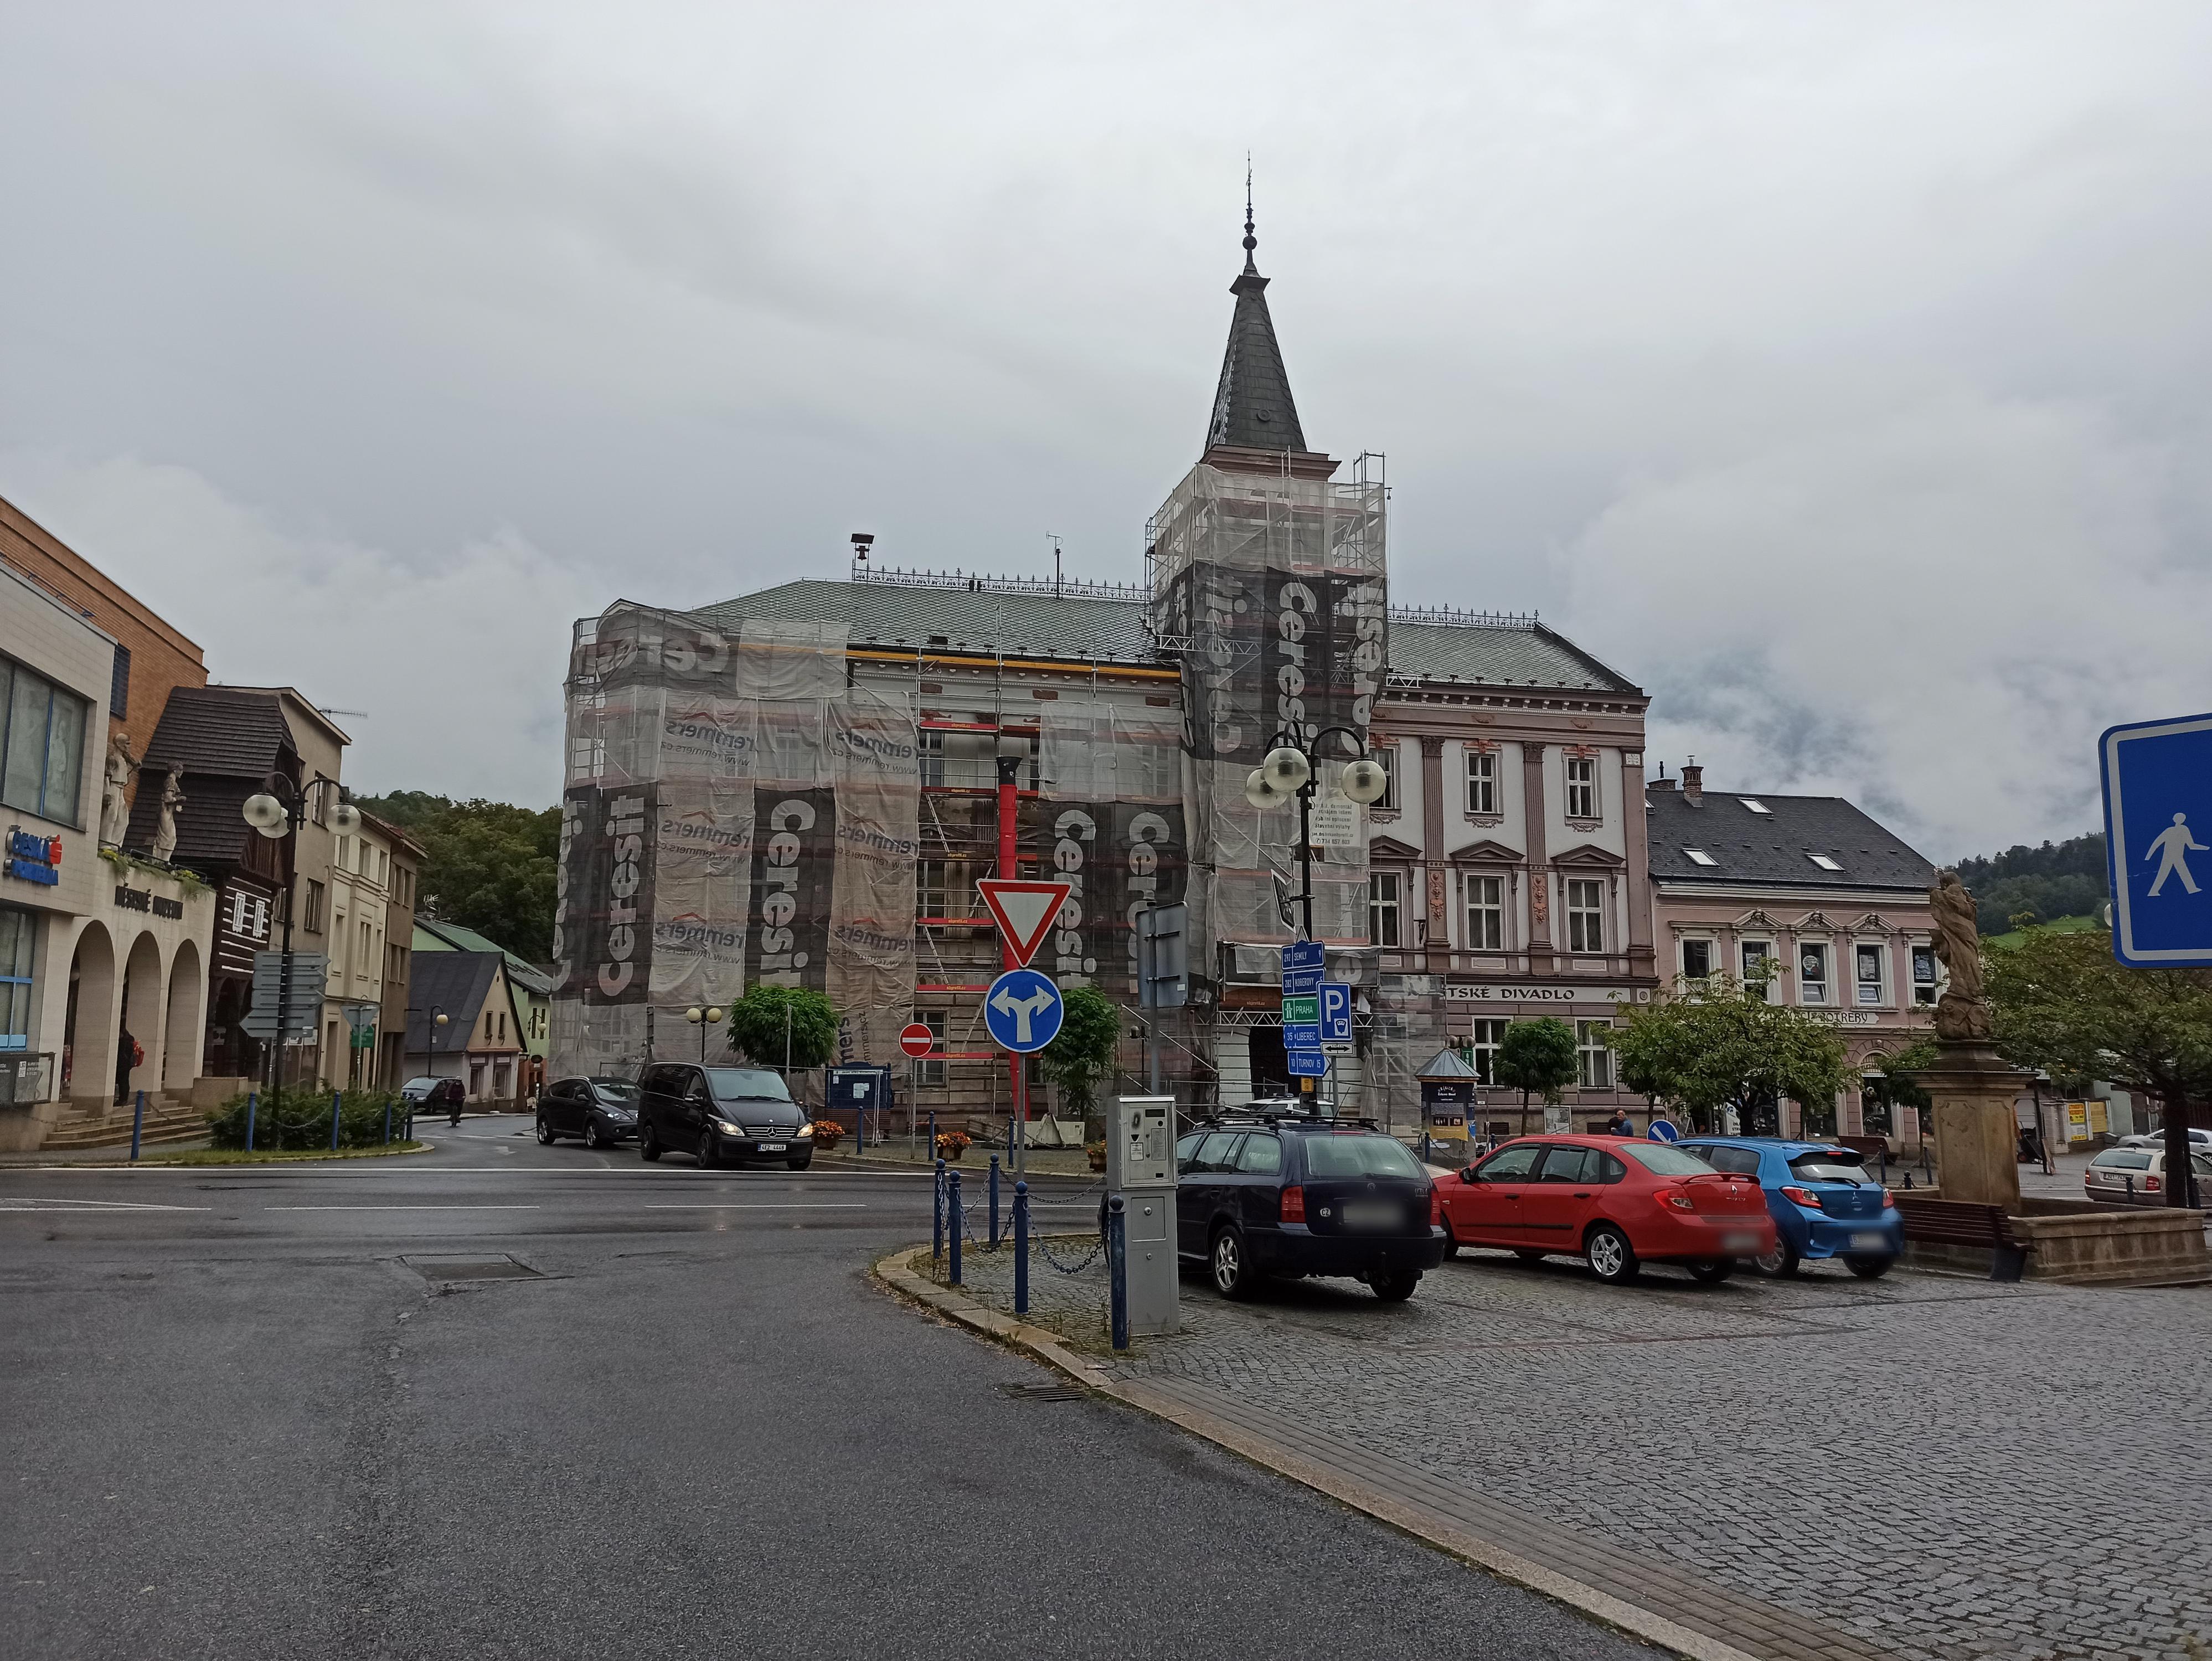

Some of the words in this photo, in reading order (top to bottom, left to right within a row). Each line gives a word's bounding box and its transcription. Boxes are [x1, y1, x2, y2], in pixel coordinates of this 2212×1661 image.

[1277, 582, 1317, 747] Ceresi
[598, 795, 644, 997] Ceresit
[759, 799, 816, 989] Ceresit
[1054, 809, 1097, 990] Ceresit
[1294, 951, 1307, 961] SEMILY
[1318, 950, 1321, 958] 9
[1295, 977, 1314, 987] KOBEROVY
[1446, 986, 1491, 998] TSKÉ
[1500, 988, 1575, 1000] DIVADLO
[1296, 1005, 1313, 1014] PRAHA
[1325, 990, 1344, 1023] P
[838, 1017, 855, 1062] mers
[858, 1011, 872, 1064] mmers.cz
[1287, 1032, 1293, 1041] 35
[1297, 1032, 1316, 1041] LIBEREC
[1291, 1058, 1295, 1066] 10
[1298, 1059, 1314, 1068] TURNOV
[1316, 1059, 1321, 1068] 15
